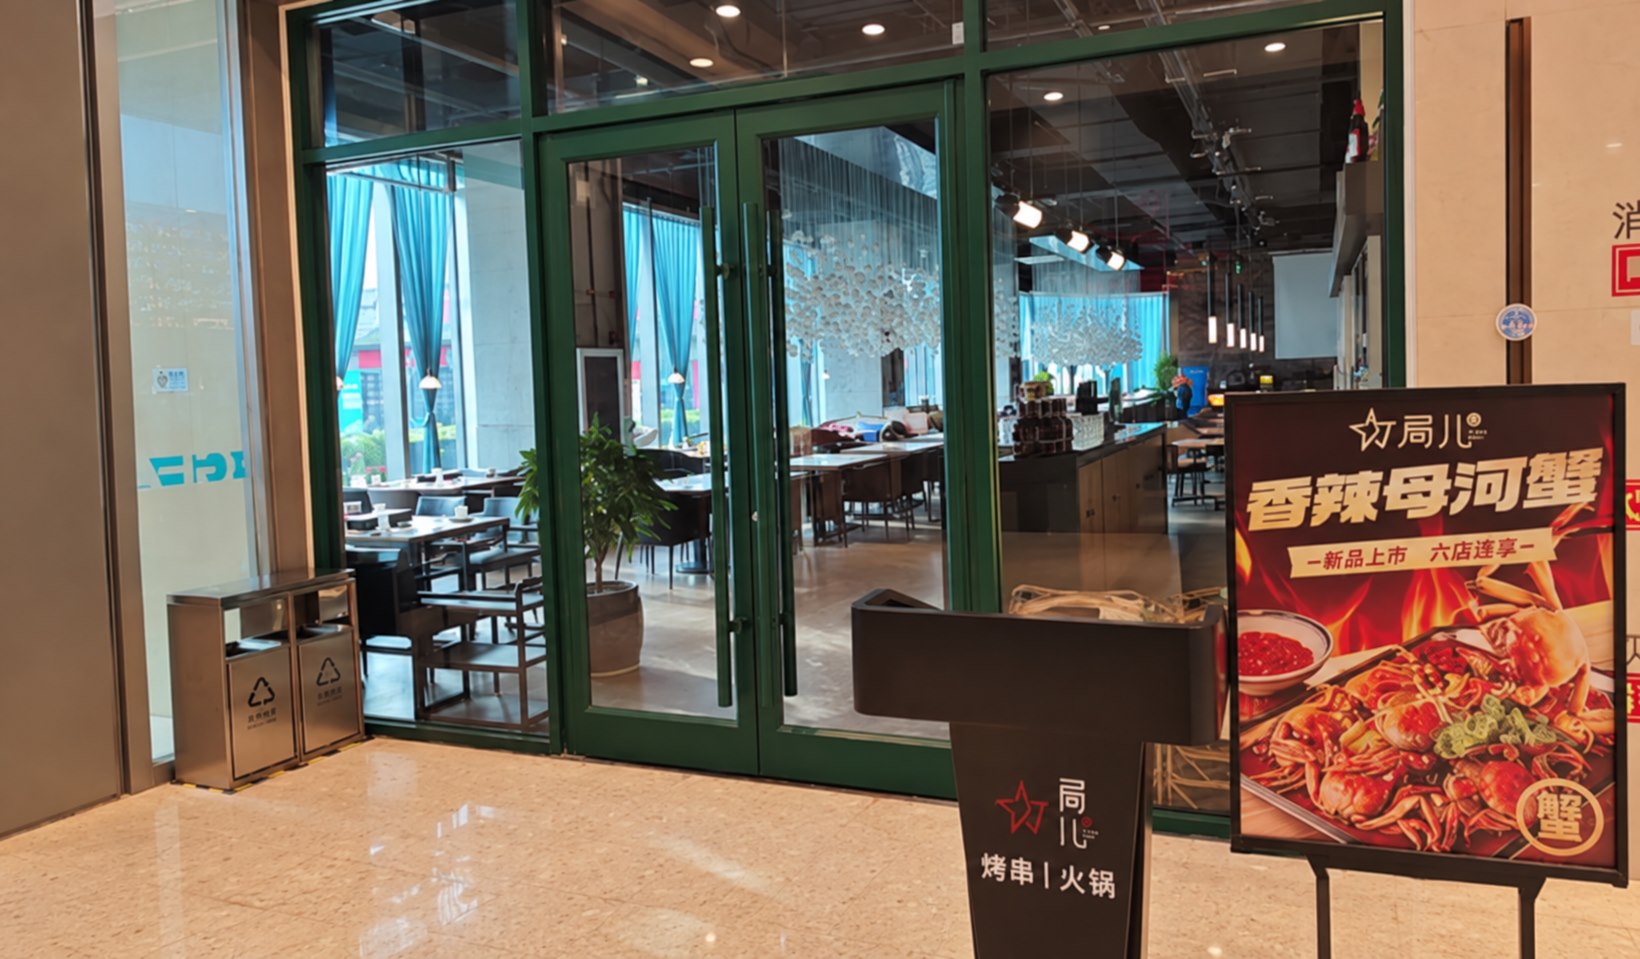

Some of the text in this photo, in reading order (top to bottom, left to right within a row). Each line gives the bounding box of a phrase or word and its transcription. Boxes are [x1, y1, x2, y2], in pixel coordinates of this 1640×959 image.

[1246, 447, 1604, 532] 香辣母河蟹
[1536, 790, 1583, 843] 蟹
